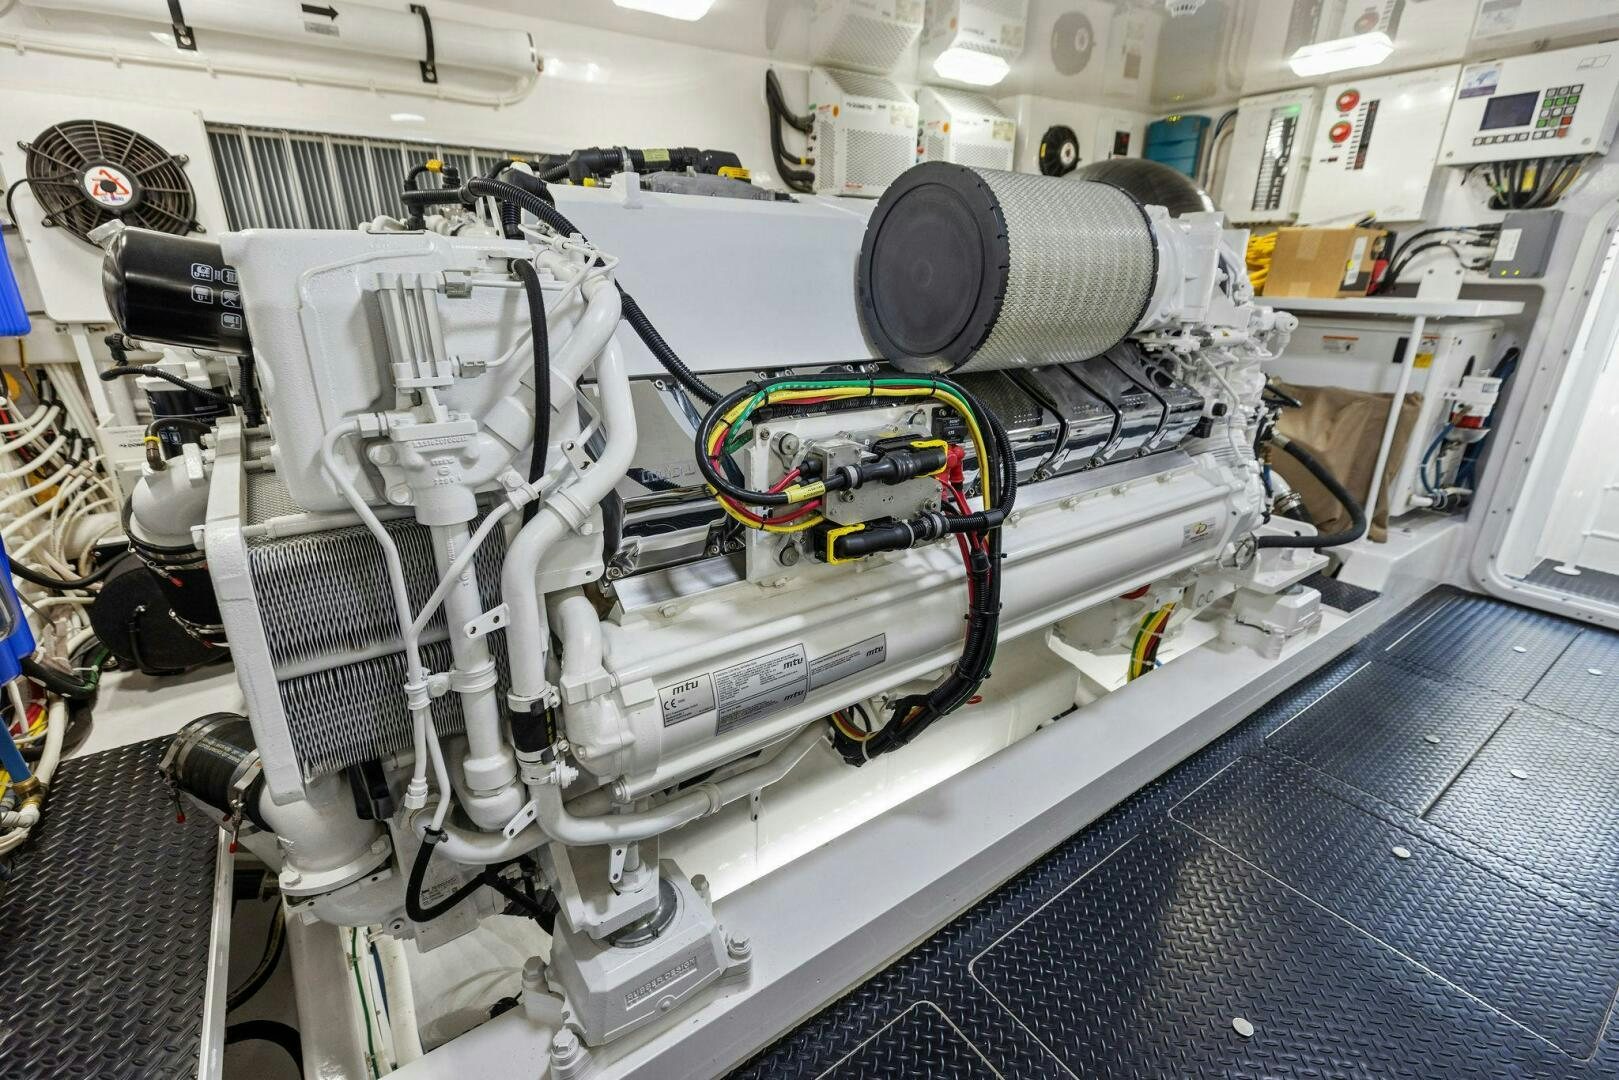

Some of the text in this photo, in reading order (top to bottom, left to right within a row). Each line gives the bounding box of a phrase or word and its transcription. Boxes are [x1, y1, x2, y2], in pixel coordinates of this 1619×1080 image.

[866, 646, 884, 657] mtu
[783, 657, 804, 670] mtu
[672, 680, 699, 695] mtu
[783, 689, 805, 701] mtu
